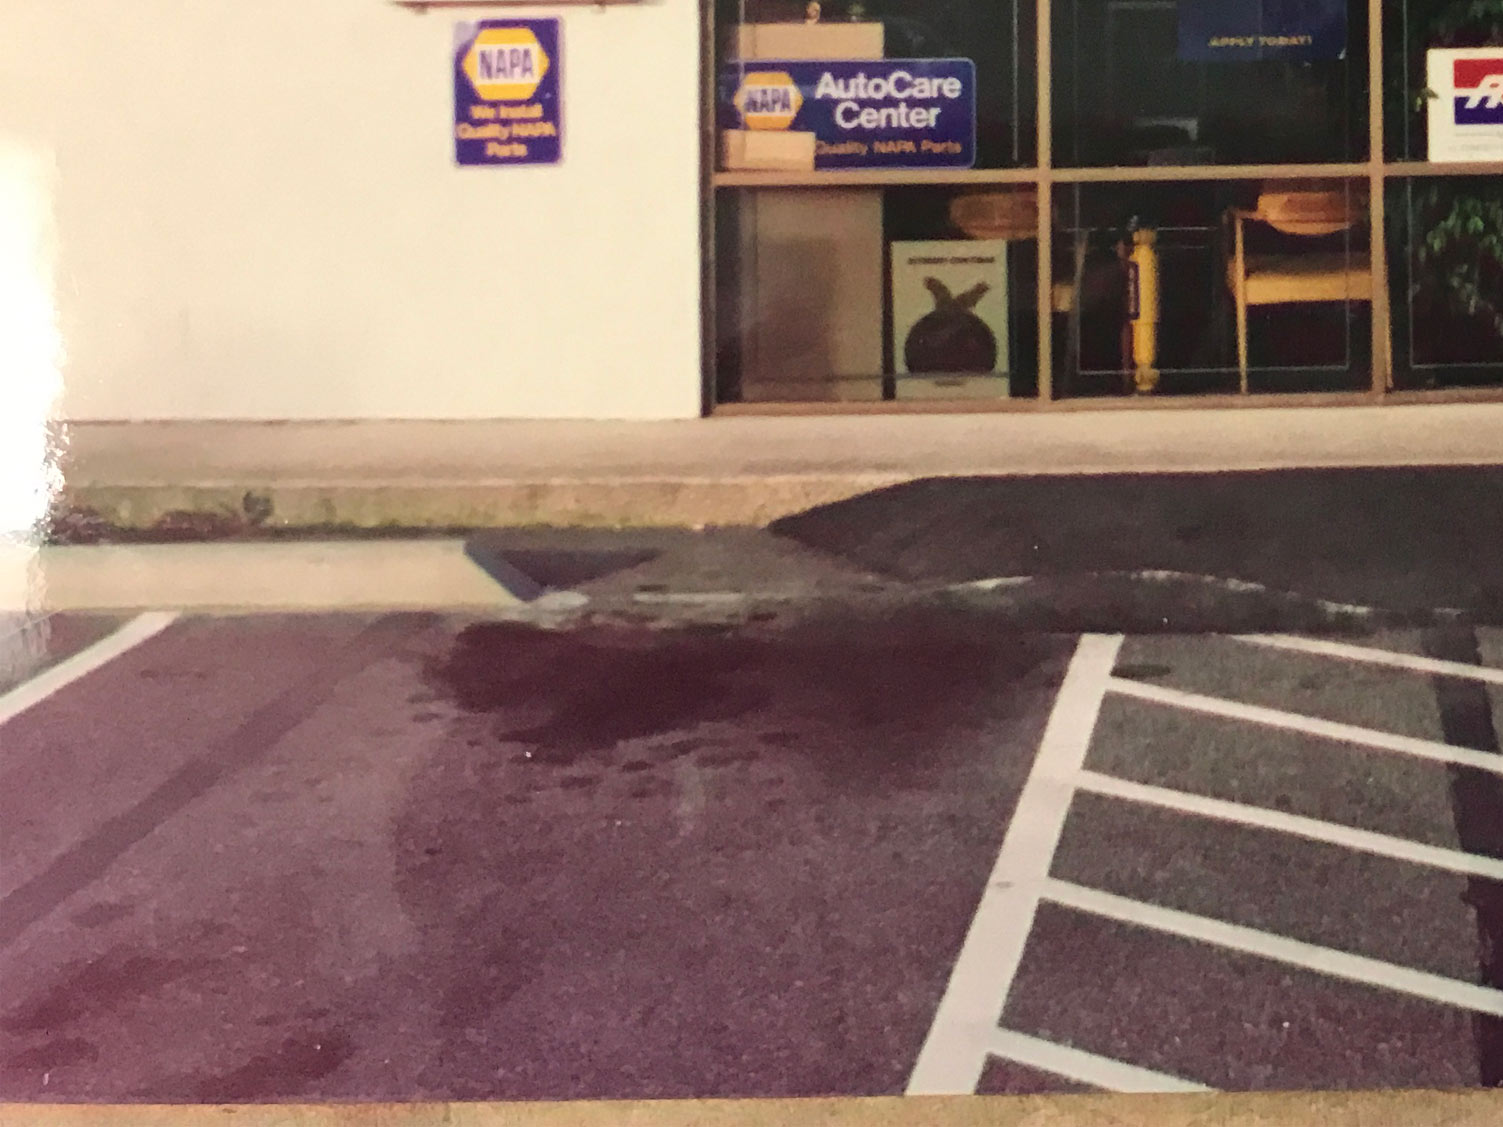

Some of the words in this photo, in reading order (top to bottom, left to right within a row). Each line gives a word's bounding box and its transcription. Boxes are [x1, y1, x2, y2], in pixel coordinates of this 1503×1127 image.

[480, 48, 534, 80] NAPA
[815, 70, 963, 100] AutoCare
[744, 87, 792, 113] NAPA
[835, 101, 942, 130] Center
